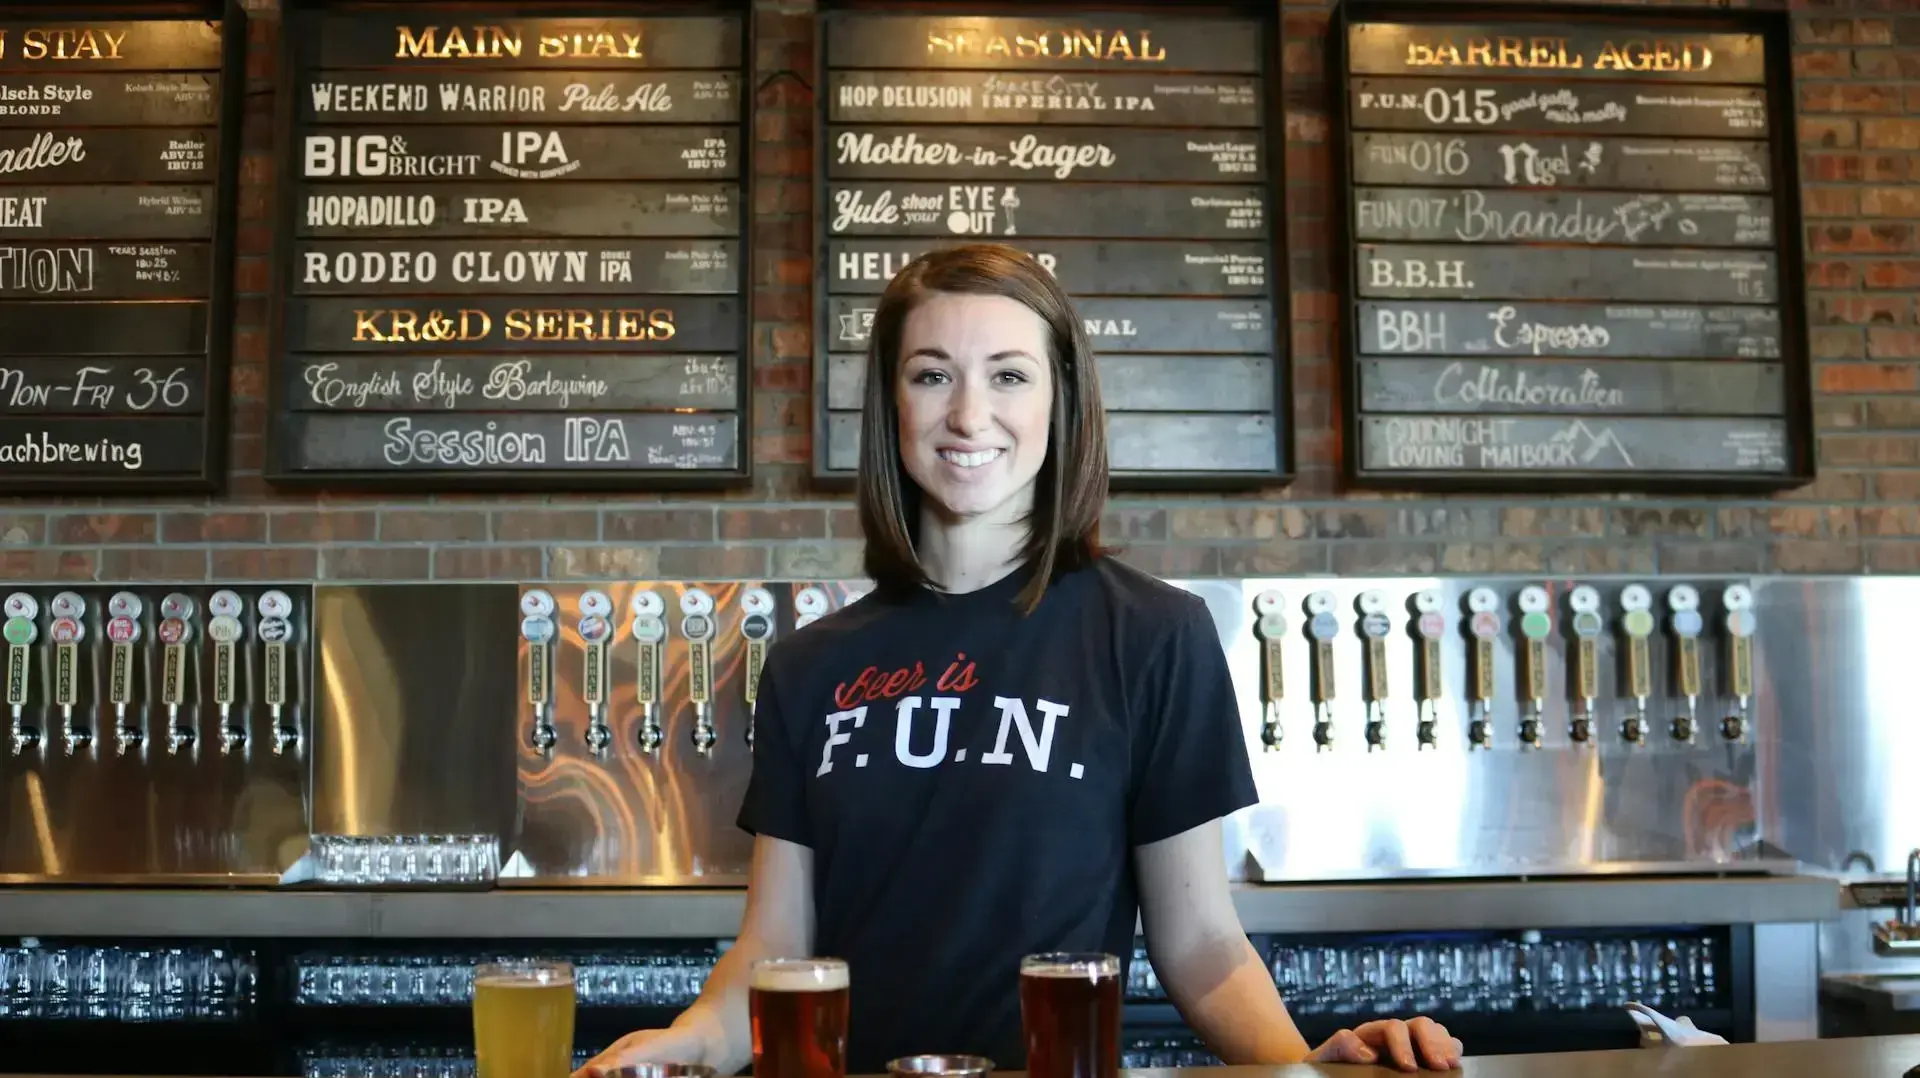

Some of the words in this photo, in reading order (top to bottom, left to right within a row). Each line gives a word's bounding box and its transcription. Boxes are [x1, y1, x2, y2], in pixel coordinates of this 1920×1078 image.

[23, 29, 128, 59] STAY
[395, 25, 524, 58] MAIN
[538, 24, 643, 58] STAY
[927, 29, 1166, 60] SEASONAL
[1406, 36, 1583, 68] BARREL
[1593, 39, 1713, 72] AGED
[0, 85, 40, 100] lsch
[43, 85, 92, 102] Style
[311, 82, 428, 112] WEEKEND
[439, 82, 546, 112] WARRIOR
[558, 83, 620, 112] Pale
[622, 83, 672, 112] Ale
[840, 86, 879, 107] HOP
[883, 86, 972, 107] DELUSION
[982, 95, 1106, 109] IMPERIAL
[1114, 97, 1155, 110] IPA
[1424, 88, 1498, 124] 015
[0, 105, 61, 115] BLONDE
[160, 151, 185, 160] ABV
[169, 141, 205, 149] Radler
[304, 134, 388, 176] BIG
[389, 134, 408, 154] &
[502, 131, 568, 164] IPA
[1410, 139, 1469, 175] 016
[168, 161, 189, 170] IBU
[389, 155, 481, 176] BRIGHT
[307, 195, 436, 226] HOPADILLO
[463, 198, 528, 223] IPA
[832, 190, 899, 232] Yule
[901, 194, 943, 210] shoot
[949, 186, 995, 211] EYE
[903, 211, 940, 225] your
[303, 251, 437, 284] RODEO
[452, 251, 588, 283] CLOWN
[600, 261, 632, 283] IPA
[1370, 260, 1475, 288] B.B.H.
[352, 309, 492, 342] KR&D
[505, 308, 676, 342] SERIES
[1377, 309, 1445, 351] BBH
[1488, 306, 1610, 355] Espresso
[126, 367, 189, 410] 3-6
[305, 362, 402, 408] English
[413, 359, 474, 409] Style
[483, 359, 608, 408] Barleywine
[384, 417, 546, 465] Session
[564, 417, 630, 462] IPA
[1387, 444, 1465, 468] LOVING
[1481, 442, 1577, 469] MAIBOCK
[835, 660, 928, 710] Beer
[936, 652, 979, 692] is
[816, 695, 1085, 779] F.U.N.
